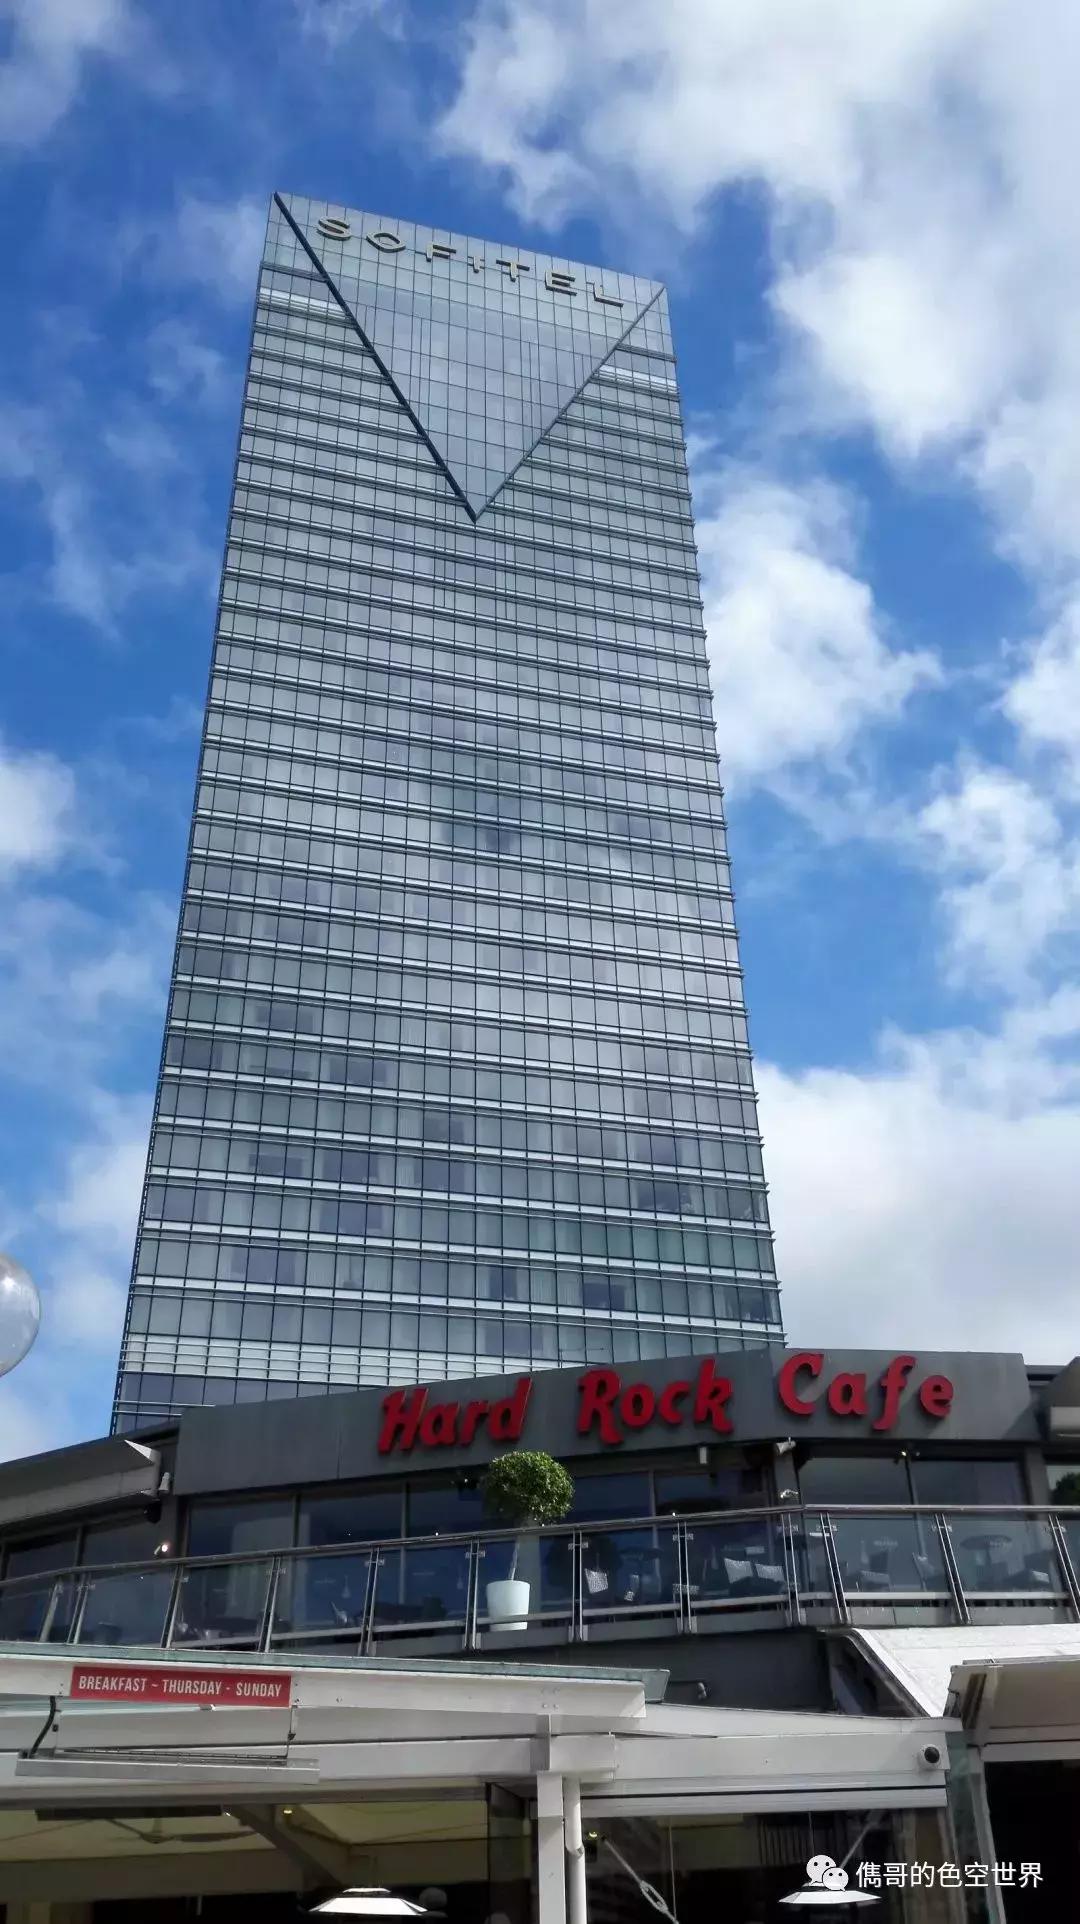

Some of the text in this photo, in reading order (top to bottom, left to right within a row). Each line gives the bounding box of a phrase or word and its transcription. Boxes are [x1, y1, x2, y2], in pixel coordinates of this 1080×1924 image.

[315, 216, 624, 308] SOFITEL
[377, 1353, 955, 1454] Hard Rock Cafe
[78, 1675, 148, 1692] BREAKFAST
[162, 1679, 222, 1695] THURSDAY
[235, 1682, 282, 1697] SUNDAY
